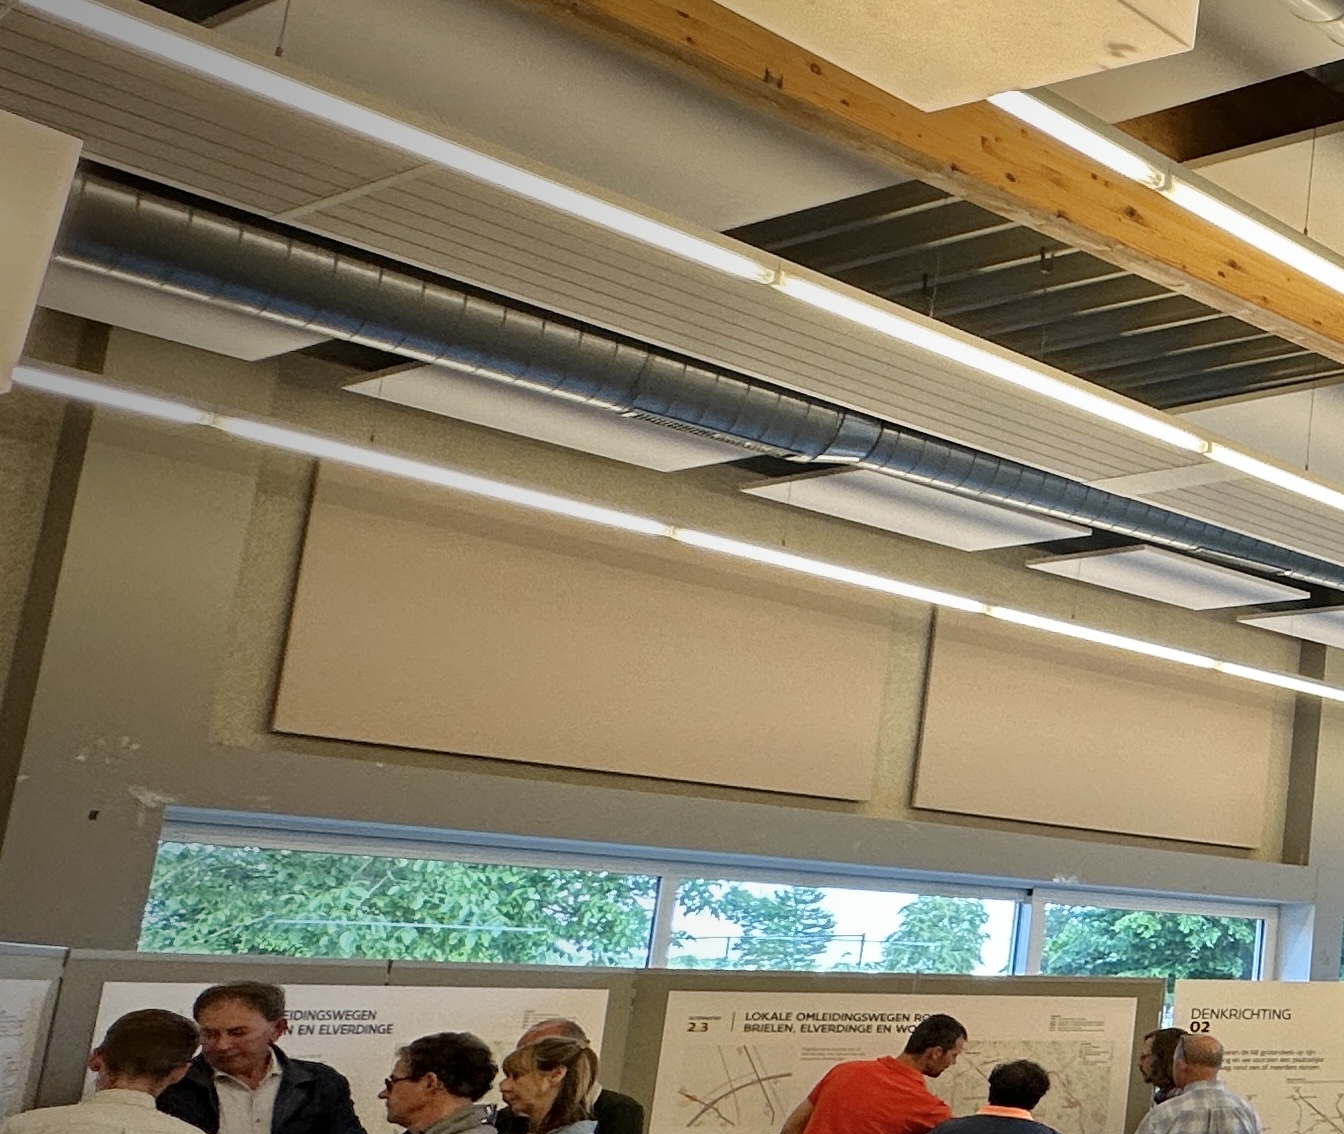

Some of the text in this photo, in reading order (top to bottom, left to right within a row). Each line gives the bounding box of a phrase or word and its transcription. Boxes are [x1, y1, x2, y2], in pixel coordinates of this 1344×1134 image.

[745, 1012, 793, 1021] LOKALE
[796, 1012, 910, 1022] OMLEIDINGSWEGEN
[1190, 1008, 1292, 1020] DENKRICHTING
[298, 1024, 315, 1035] EN
[318, 1023, 394, 1035] ELVERDINGE
[800, 1024, 873, 1034] ELVERDINGE
[876, 1024, 891, 1034] EN
[1190, 1021, 1210, 1033] 02
